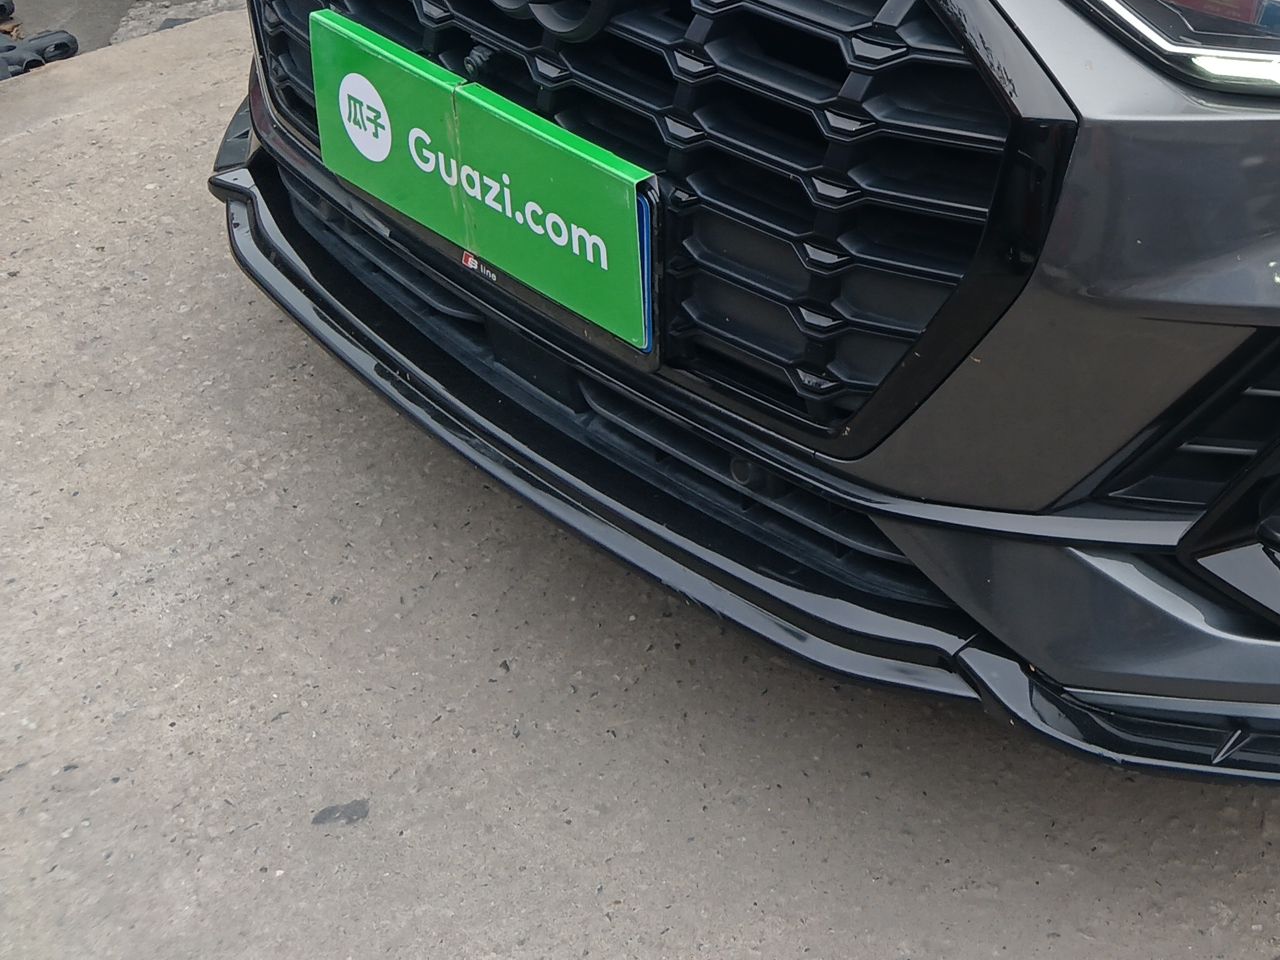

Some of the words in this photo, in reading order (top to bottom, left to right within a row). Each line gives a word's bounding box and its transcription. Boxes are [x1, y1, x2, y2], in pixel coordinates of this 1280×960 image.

[346, 93, 386, 140] 瓜子
[408, 127, 609, 271] Guazi.com
[480, 264, 497, 281] line
